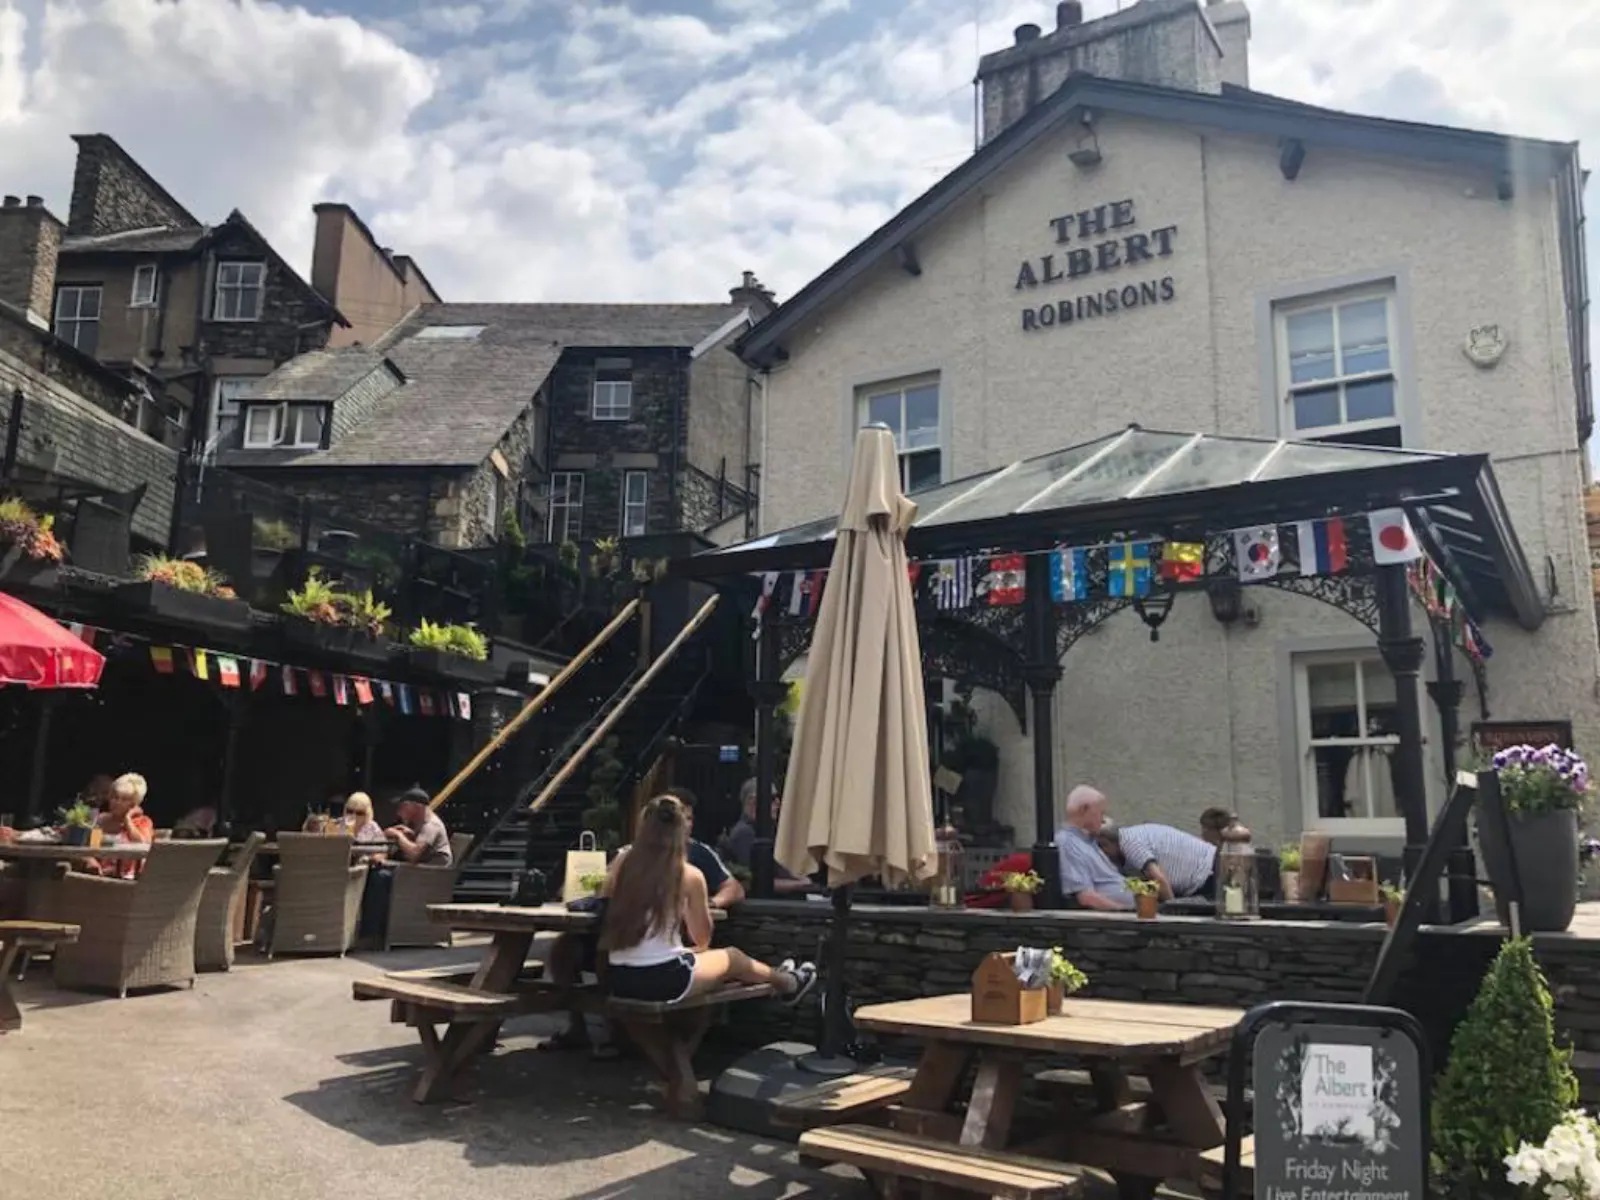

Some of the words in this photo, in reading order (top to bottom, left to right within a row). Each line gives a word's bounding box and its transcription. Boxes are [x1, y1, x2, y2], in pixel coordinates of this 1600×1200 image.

[1049, 198, 1136, 243] THE
[1015, 224, 1178, 289] ALBERT
[1022, 276, 1175, 331] ROBINSONS
[1314, 1054, 1346, 1074] The
[1315, 1076, 1367, 1097] Albert
[1285, 1157, 1336, 1185] Friday
[1342, 1158, 1389, 1186] Night
